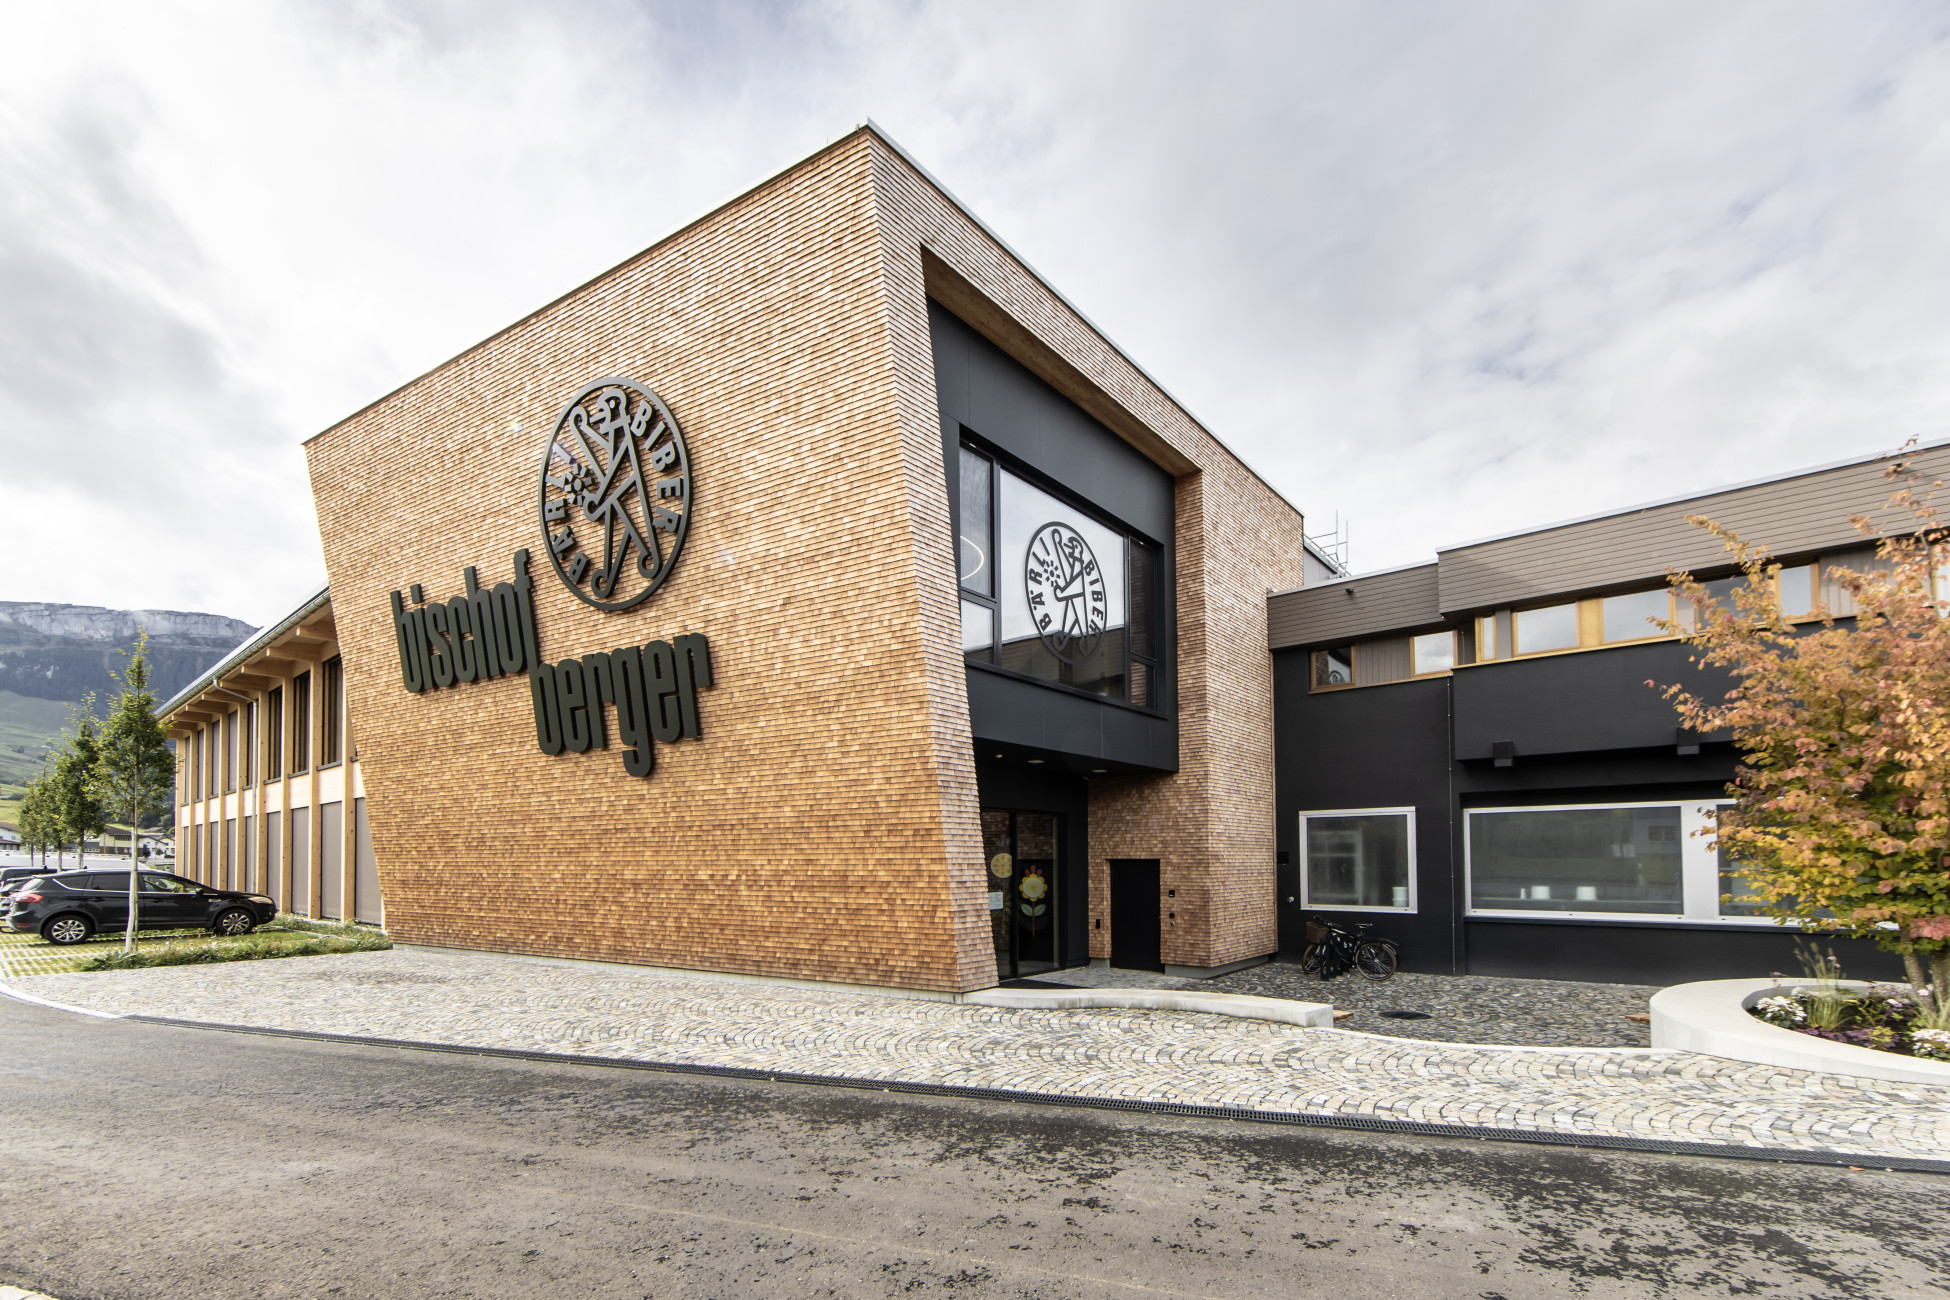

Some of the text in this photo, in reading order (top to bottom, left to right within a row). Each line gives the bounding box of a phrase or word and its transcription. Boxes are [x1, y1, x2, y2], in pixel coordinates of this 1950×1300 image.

[544, 442, 589, 584] BÄRLI
[630, 399, 678, 532] BIBER
[390, 548, 534, 694] bischof
[1029, 537, 1052, 631] BÄRLI
[1084, 559, 1104, 638] BIBER
[526, 632, 713, 778] berger
